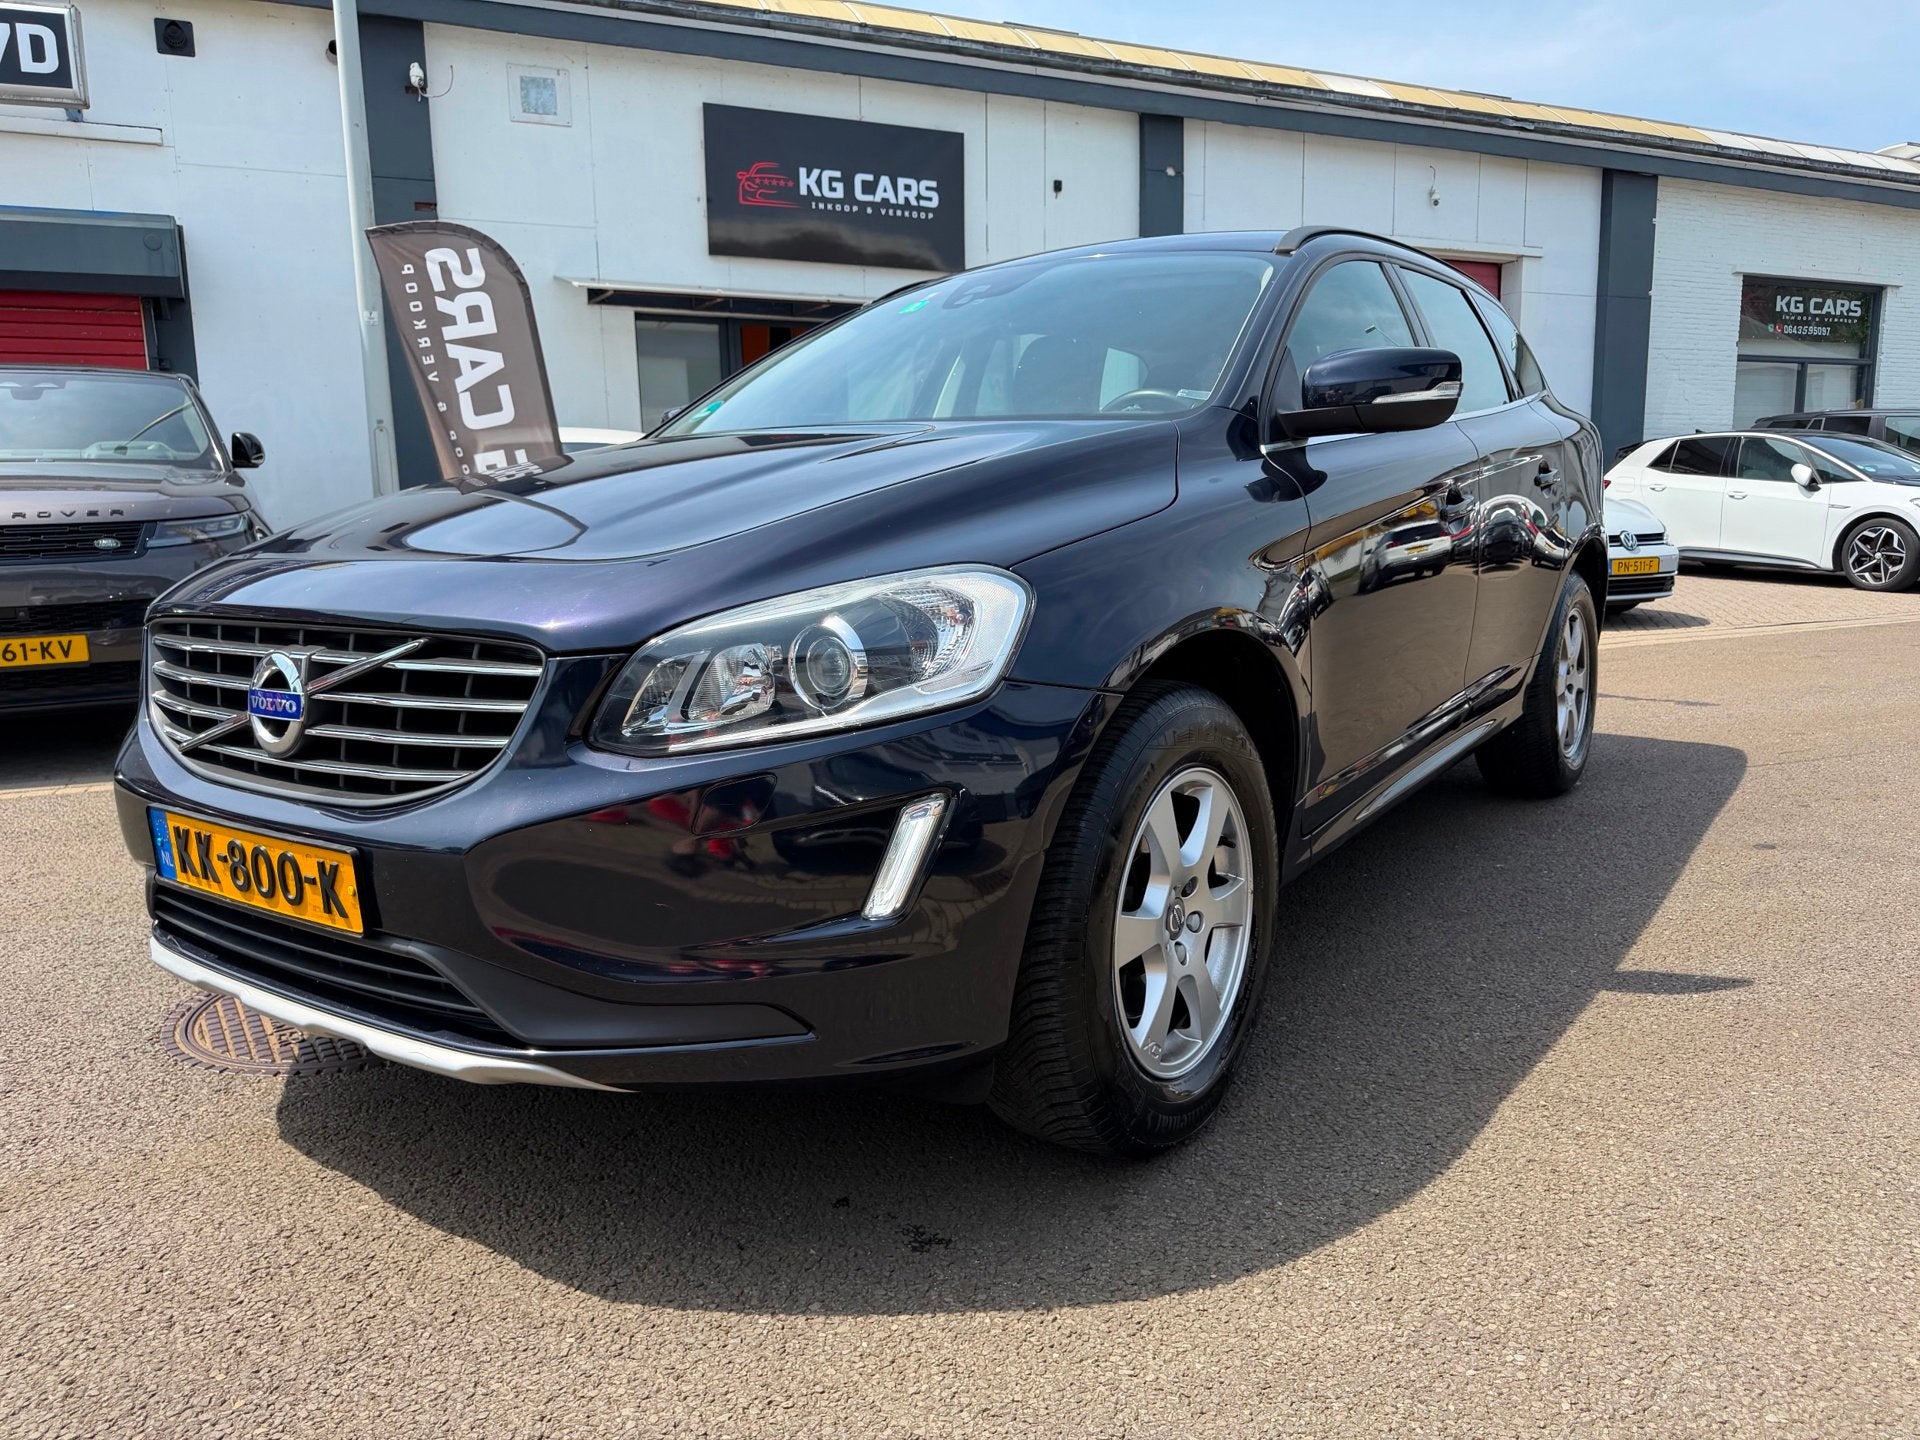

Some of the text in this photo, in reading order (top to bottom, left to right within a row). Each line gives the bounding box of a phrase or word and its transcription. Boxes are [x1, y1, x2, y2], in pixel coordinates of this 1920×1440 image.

[799, 167, 939, 208] KG CARS
[811, 202, 934, 220] INKOOP & VERKOOP
[1775, 295, 1862, 317] KG CARS
[11, 508, 124, 519] ROVER
[1617, 560, 1653, 573] PN-511-F
[250, 694, 297, 713] VOLVO
[160, 850, 174, 867] NL
[173, 825, 349, 918] KK-800-K
